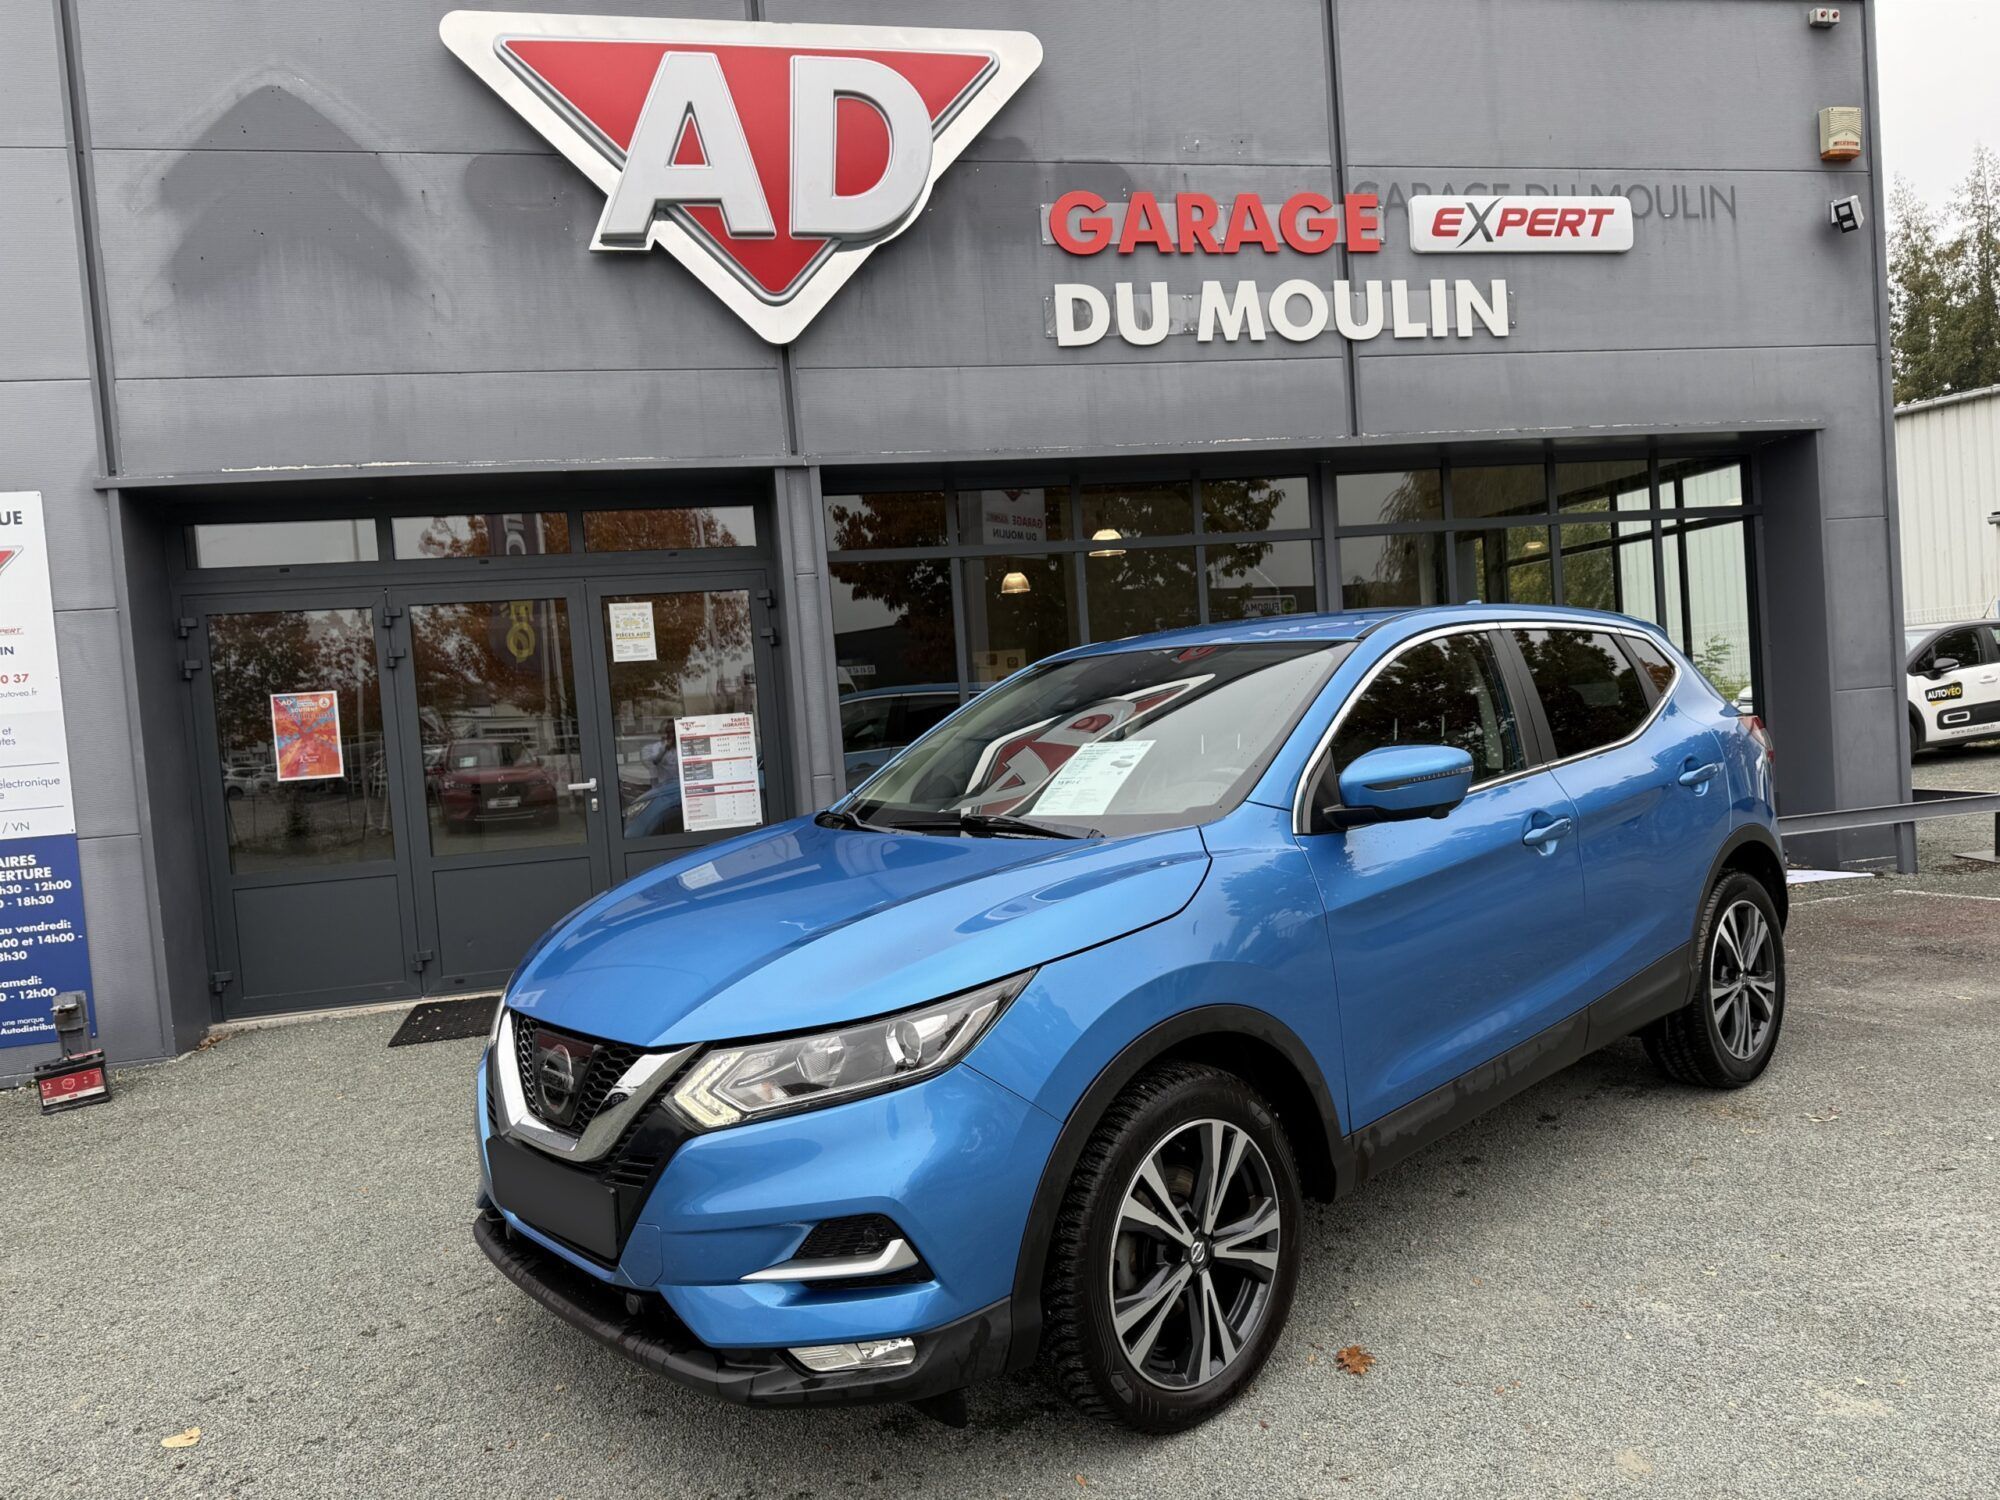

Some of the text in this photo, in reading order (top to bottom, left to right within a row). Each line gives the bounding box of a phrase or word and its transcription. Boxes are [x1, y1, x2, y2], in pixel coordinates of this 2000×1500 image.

[594, 50, 934, 247] AD
[1048, 190, 1381, 255] GARAGE
[1430, 196, 1615, 249] EXPERT
[1054, 278, 1510, 347] DU MOULIN
[13, 673, 29, 684] 37
[2, 727, 11, 736] et
[11, 822, 30, 832] VN
[34, 879, 72, 892] 12h00
[16, 894, 54, 907] 18h30
[15, 919, 72, 934] vendredi:
[21, 937, 33, 946] et
[37, 932, 75, 945] 14h00
[19, 986, 57, 1000] 12h00
[17, 1016, 45, 1025] marque
